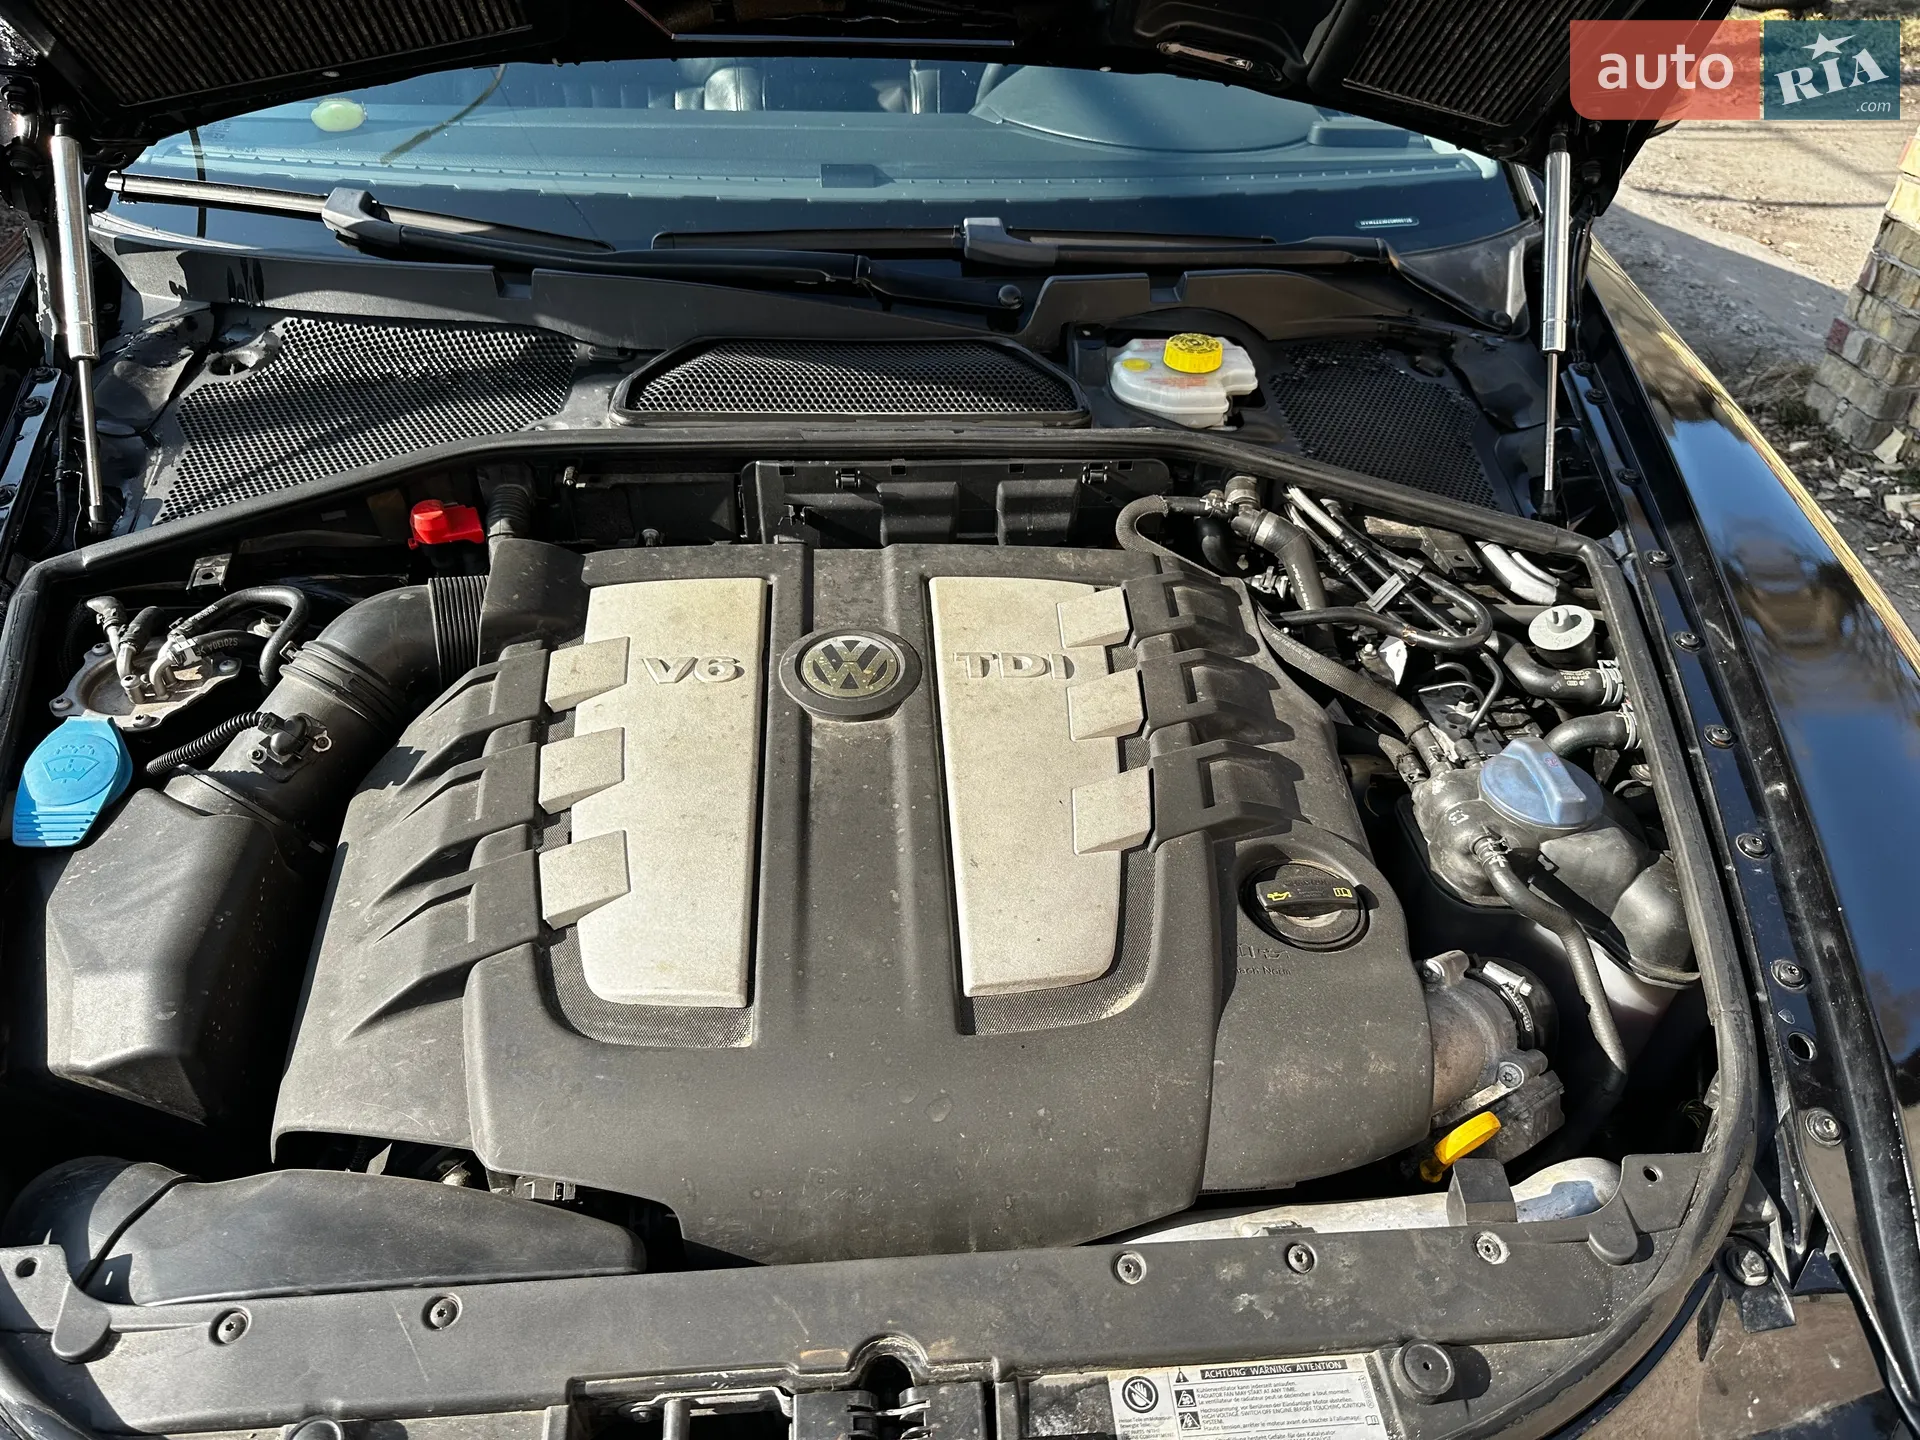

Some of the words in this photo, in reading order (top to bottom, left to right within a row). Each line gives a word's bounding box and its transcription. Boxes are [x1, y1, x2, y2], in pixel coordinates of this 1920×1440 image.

[641, 656, 739, 684] V6
[953, 651, 1067, 680] TDI
[1204, 1367, 1246, 1379] ACHTUNG
[1250, 1365, 1292, 1375] WARNING
[1296, 1361, 1342, 1371] ATTENTION
